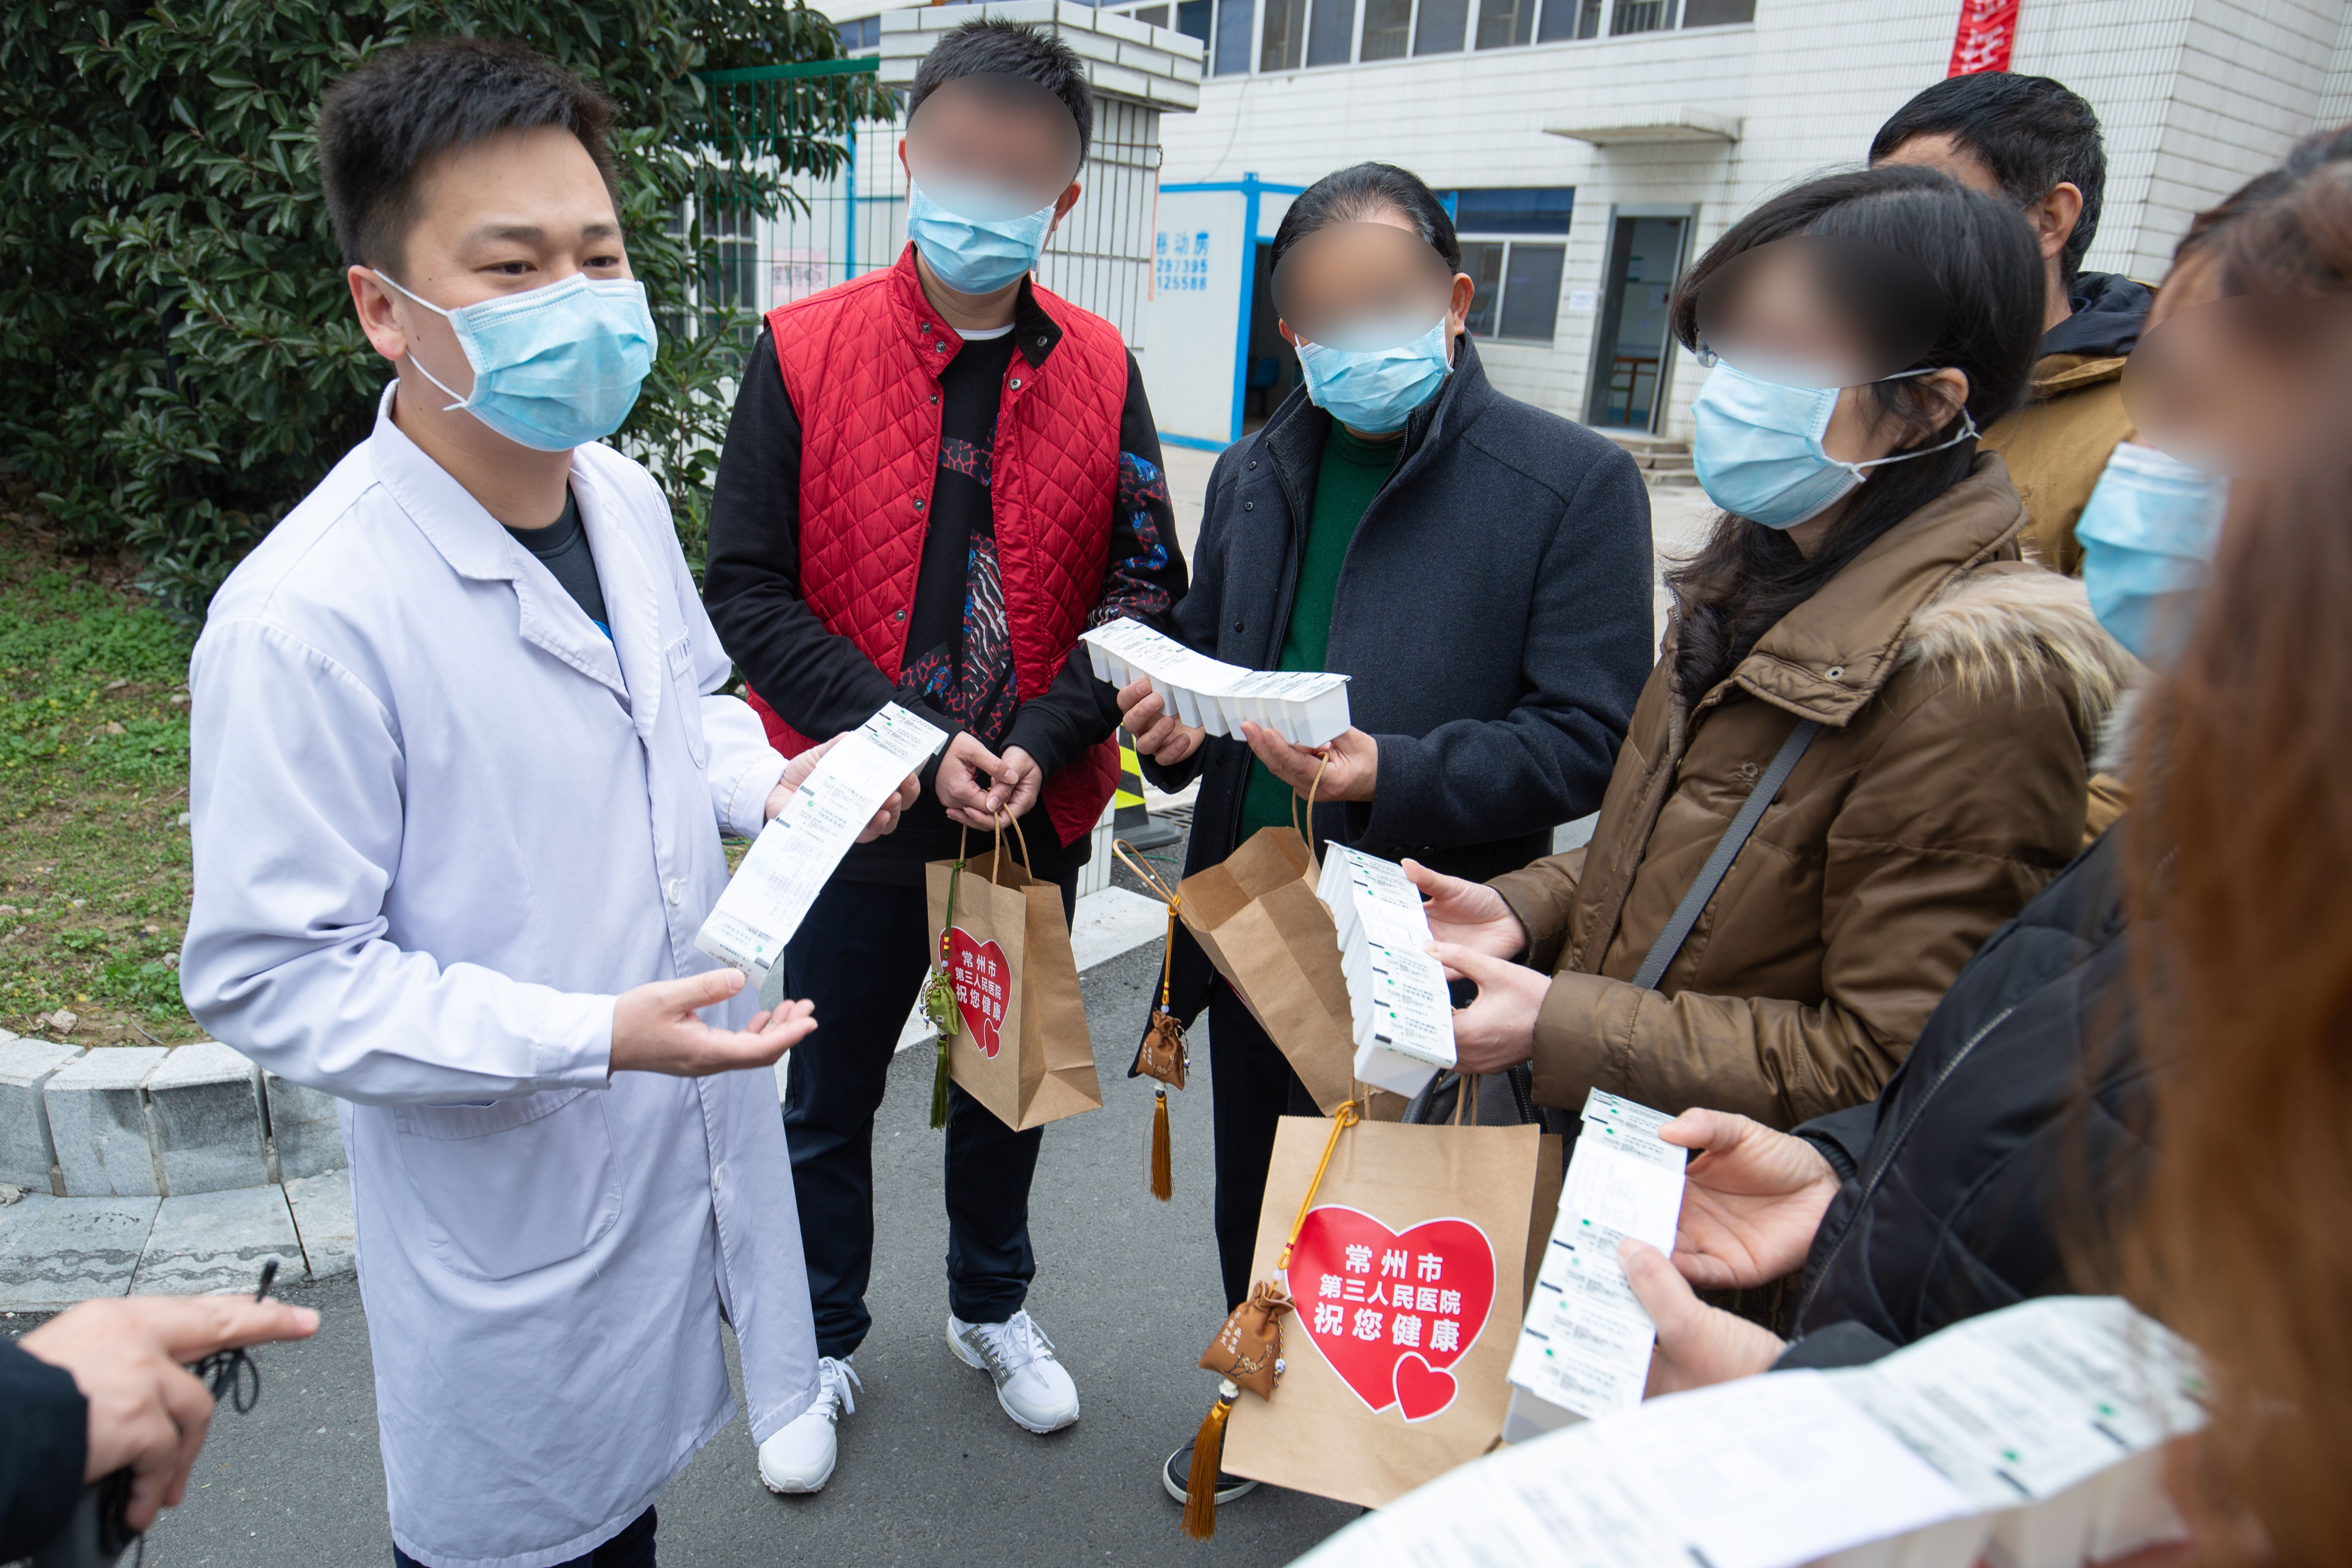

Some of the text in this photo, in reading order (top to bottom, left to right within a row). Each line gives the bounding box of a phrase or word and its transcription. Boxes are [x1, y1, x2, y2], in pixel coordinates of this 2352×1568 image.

[955, 967, 1001, 1000] 第三人民医院
[962, 951, 996, 978] 常州市
[956, 983, 1001, 1021] 祝您健康
[1345, 1244, 1443, 1283] 常州市
[1319, 1274, 1461, 1315] 第三人民医院
[1314, 1302, 1460, 1352] 祝您健康
